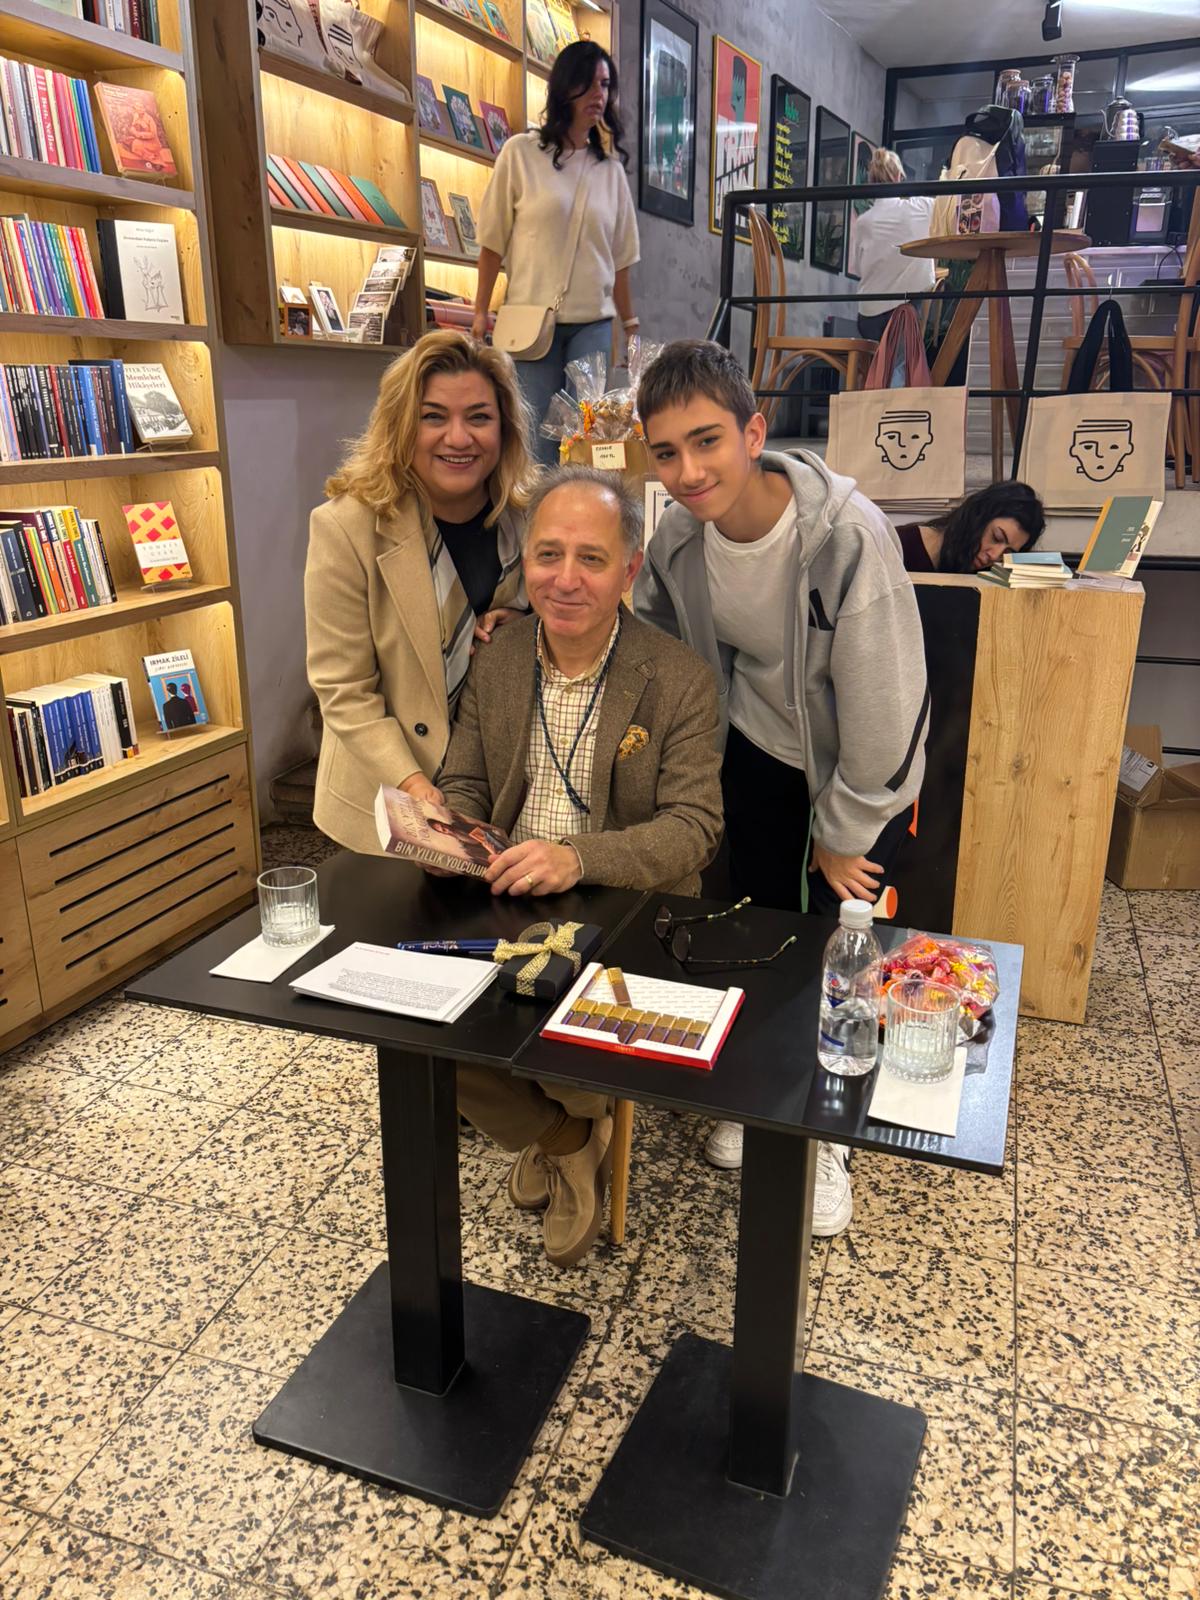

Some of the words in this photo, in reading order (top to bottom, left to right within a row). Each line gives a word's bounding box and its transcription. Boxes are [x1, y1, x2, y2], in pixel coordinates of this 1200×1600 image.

[126, 373, 161, 381] Memleket
[149, 657, 170, 666] IRMAK
[171, 652, 189, 662] ZİLELİ
[394, 840, 415, 855] BİN
[416, 847, 445, 863] YILLIK
